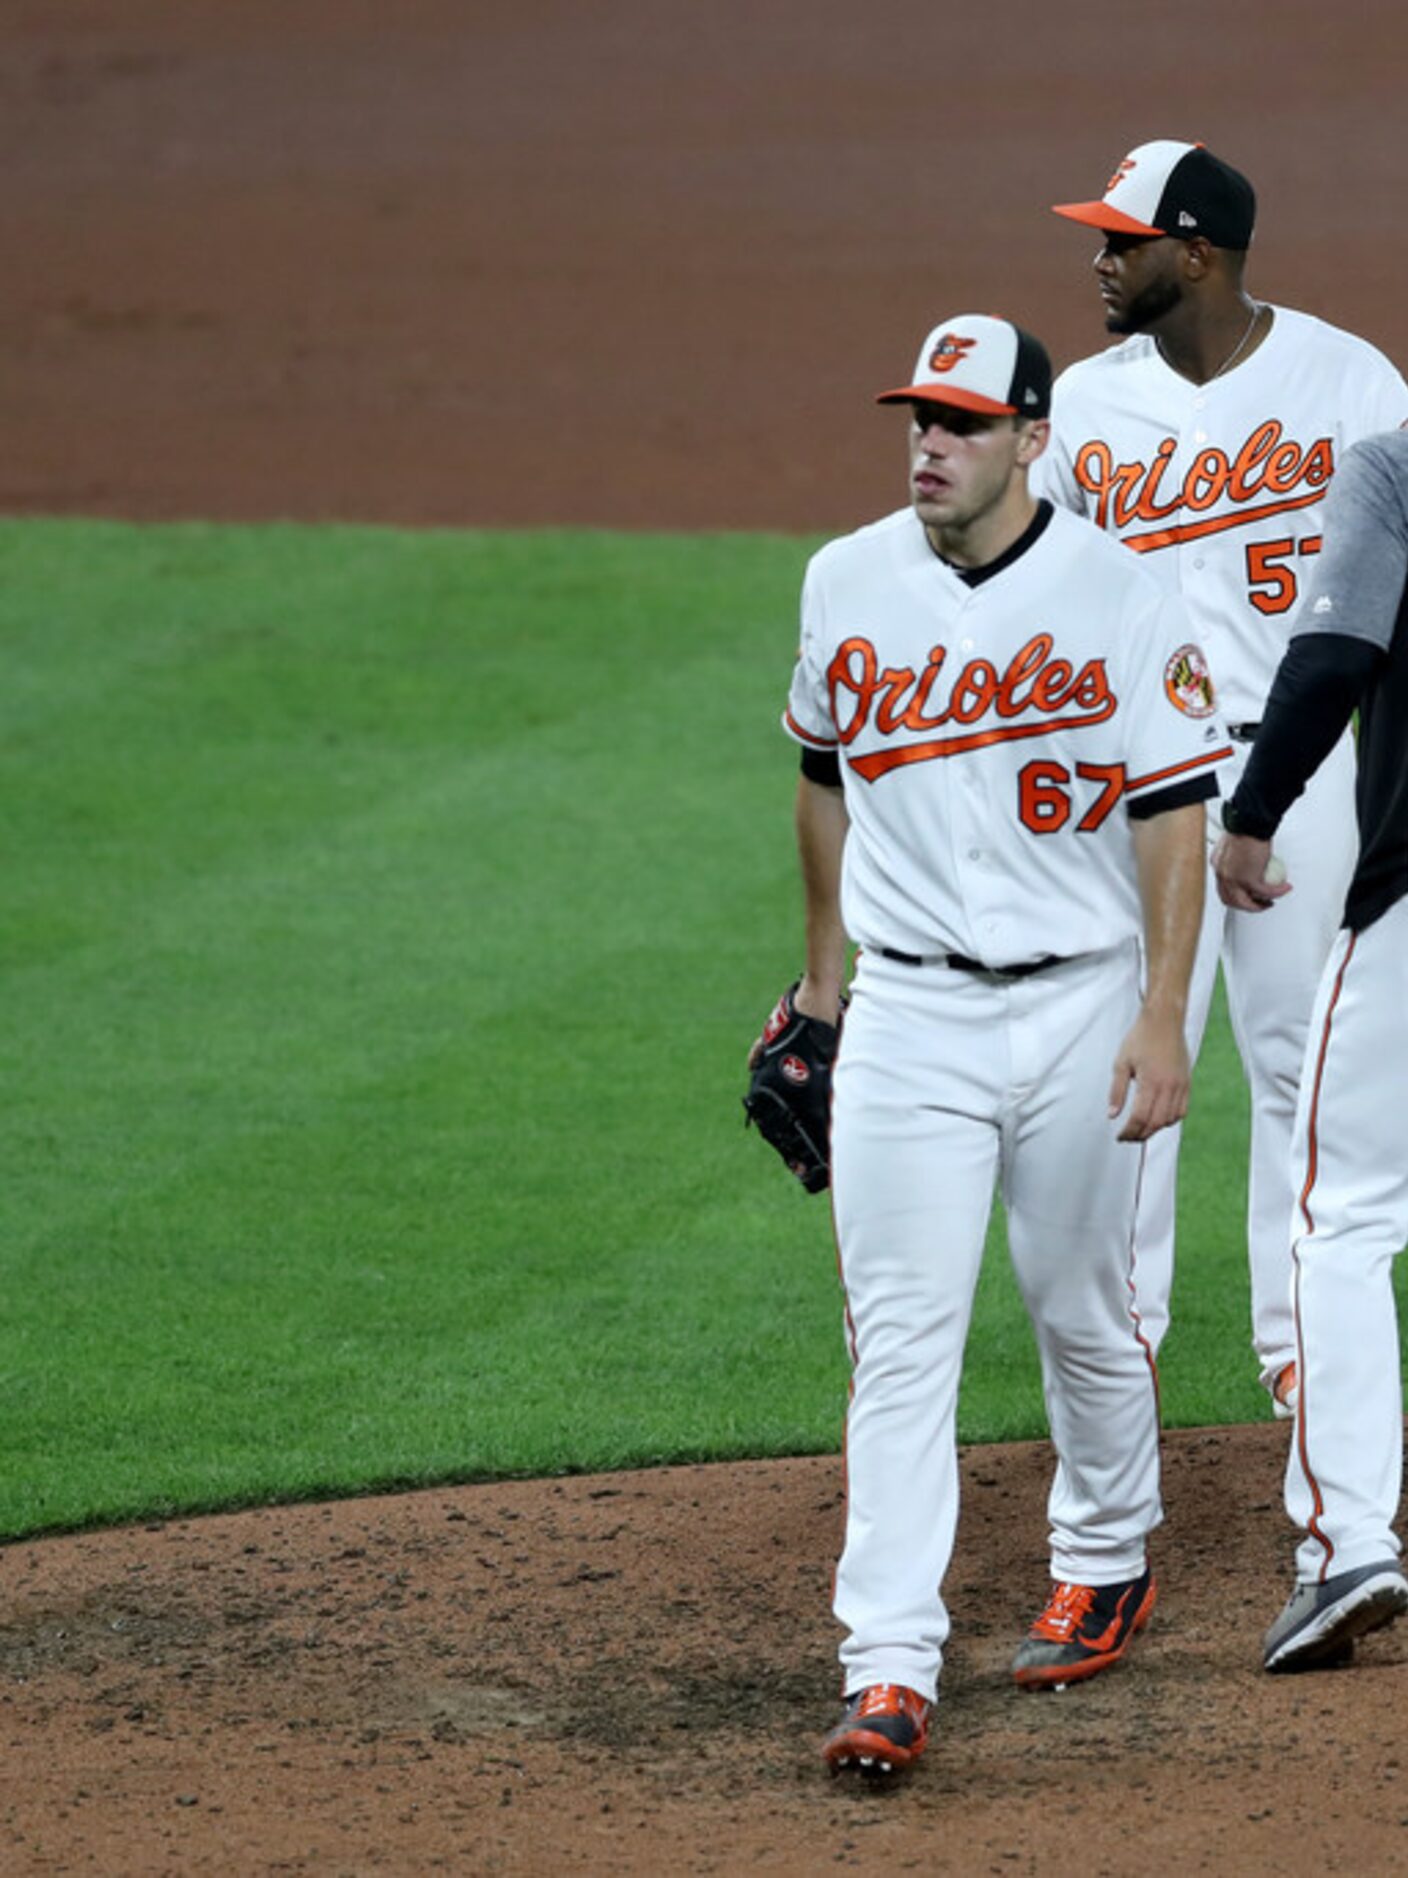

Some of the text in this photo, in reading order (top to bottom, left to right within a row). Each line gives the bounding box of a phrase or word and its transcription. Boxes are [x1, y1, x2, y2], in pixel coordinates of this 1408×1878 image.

[1073, 419, 1334, 529] Orioles
[1246, 535, 1322, 616] 5
[827, 633, 1118, 746] Orioles
[1018, 760, 1128, 834] 67
